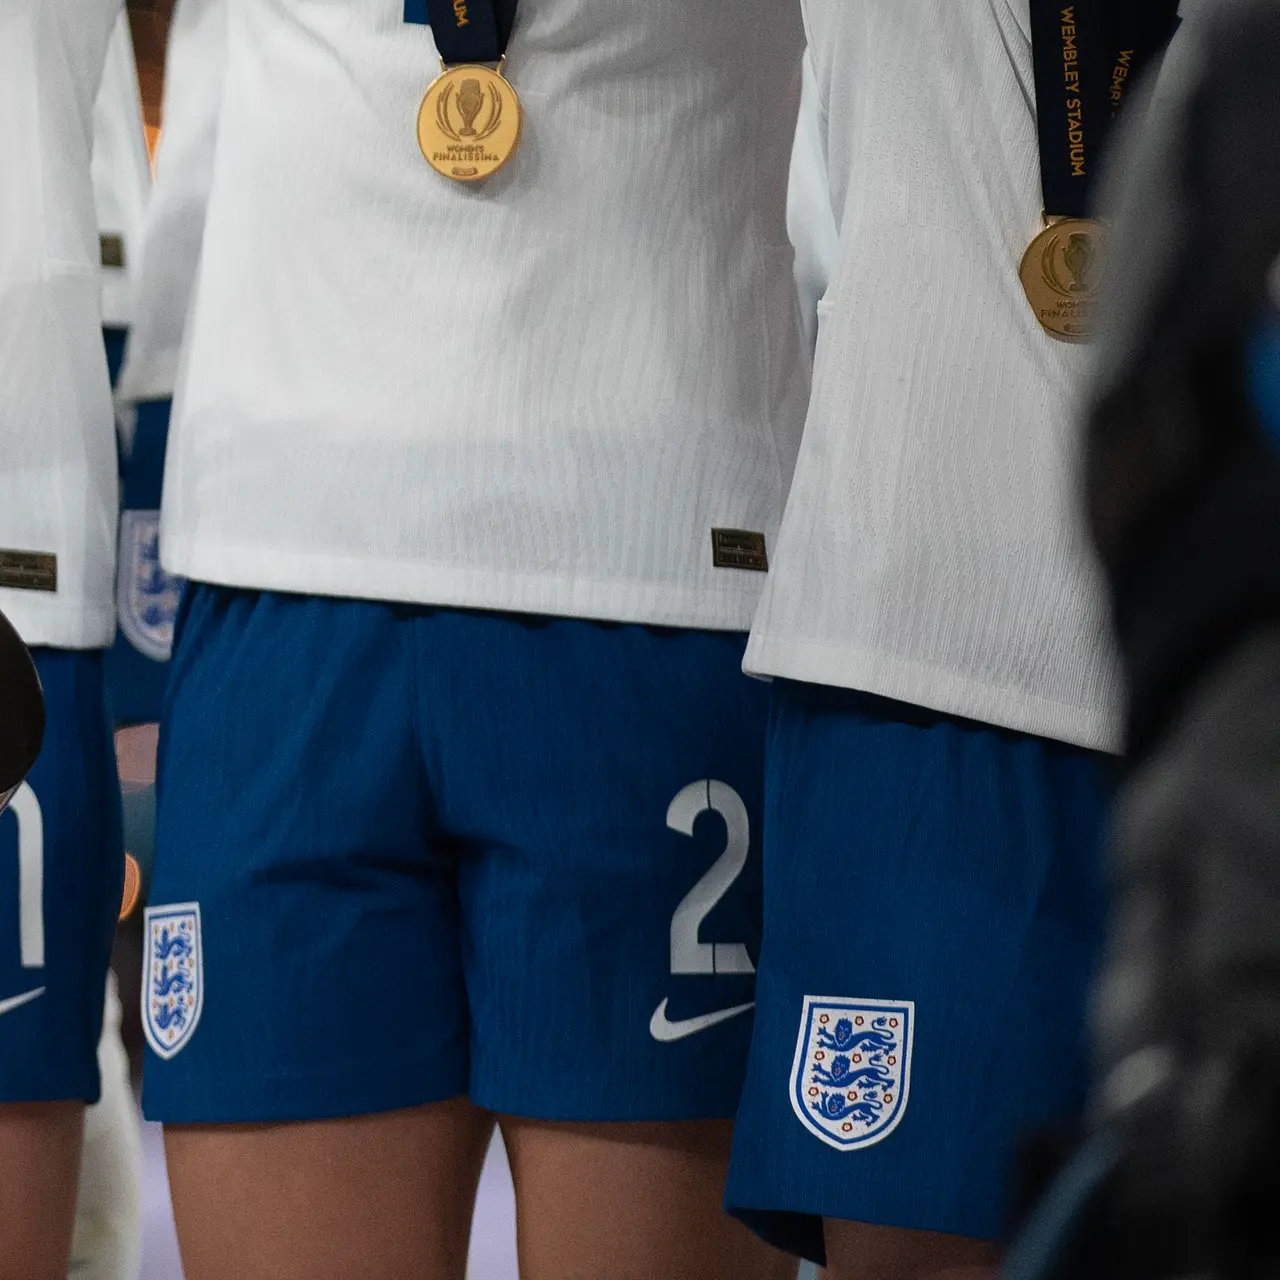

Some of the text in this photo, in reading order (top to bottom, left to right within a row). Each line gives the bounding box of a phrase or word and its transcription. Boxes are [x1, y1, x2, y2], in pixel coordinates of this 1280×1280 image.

[1060, 5, 1086, 177] WEMBLEY STADIUM
[1108, 49, 1134, 119] WEMB
[666, 778, 757, 975] 2
